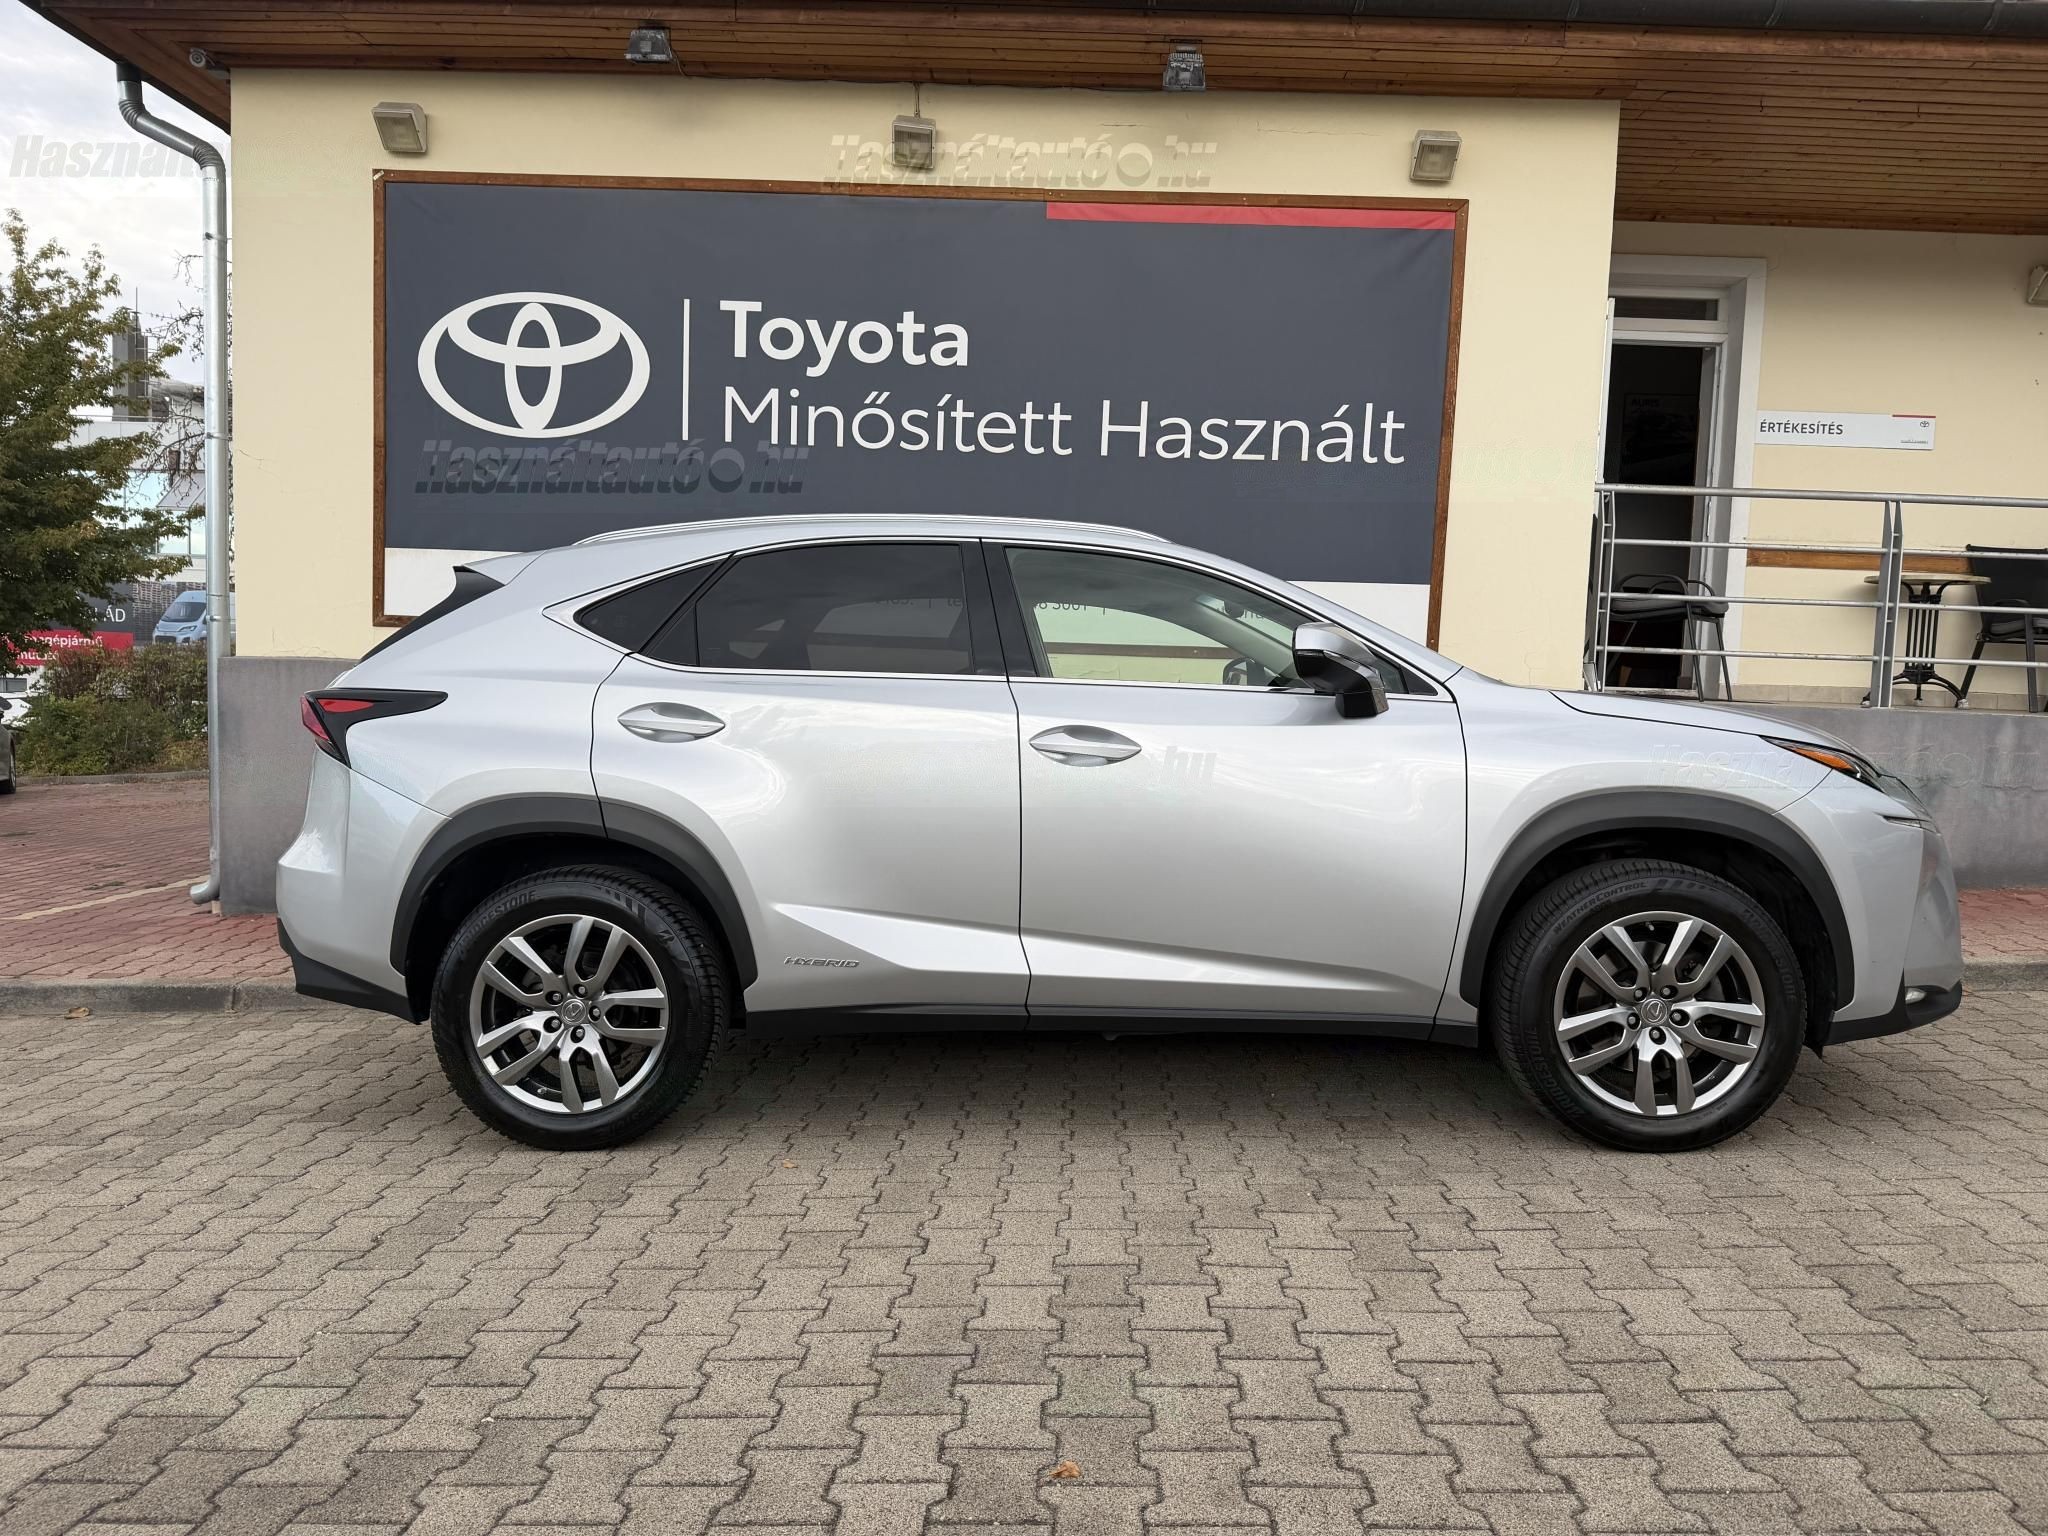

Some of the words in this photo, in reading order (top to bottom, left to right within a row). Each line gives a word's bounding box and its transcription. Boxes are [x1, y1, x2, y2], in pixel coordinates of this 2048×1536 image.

[719, 299, 969, 378] Toyota
[724, 386, 1073, 456] Minősített
[1100, 399, 1406, 464] Használt
[1759, 419, 1844, 435] ÉRTÉKESÍTÉS
[783, 956, 860, 968] HYBRID
